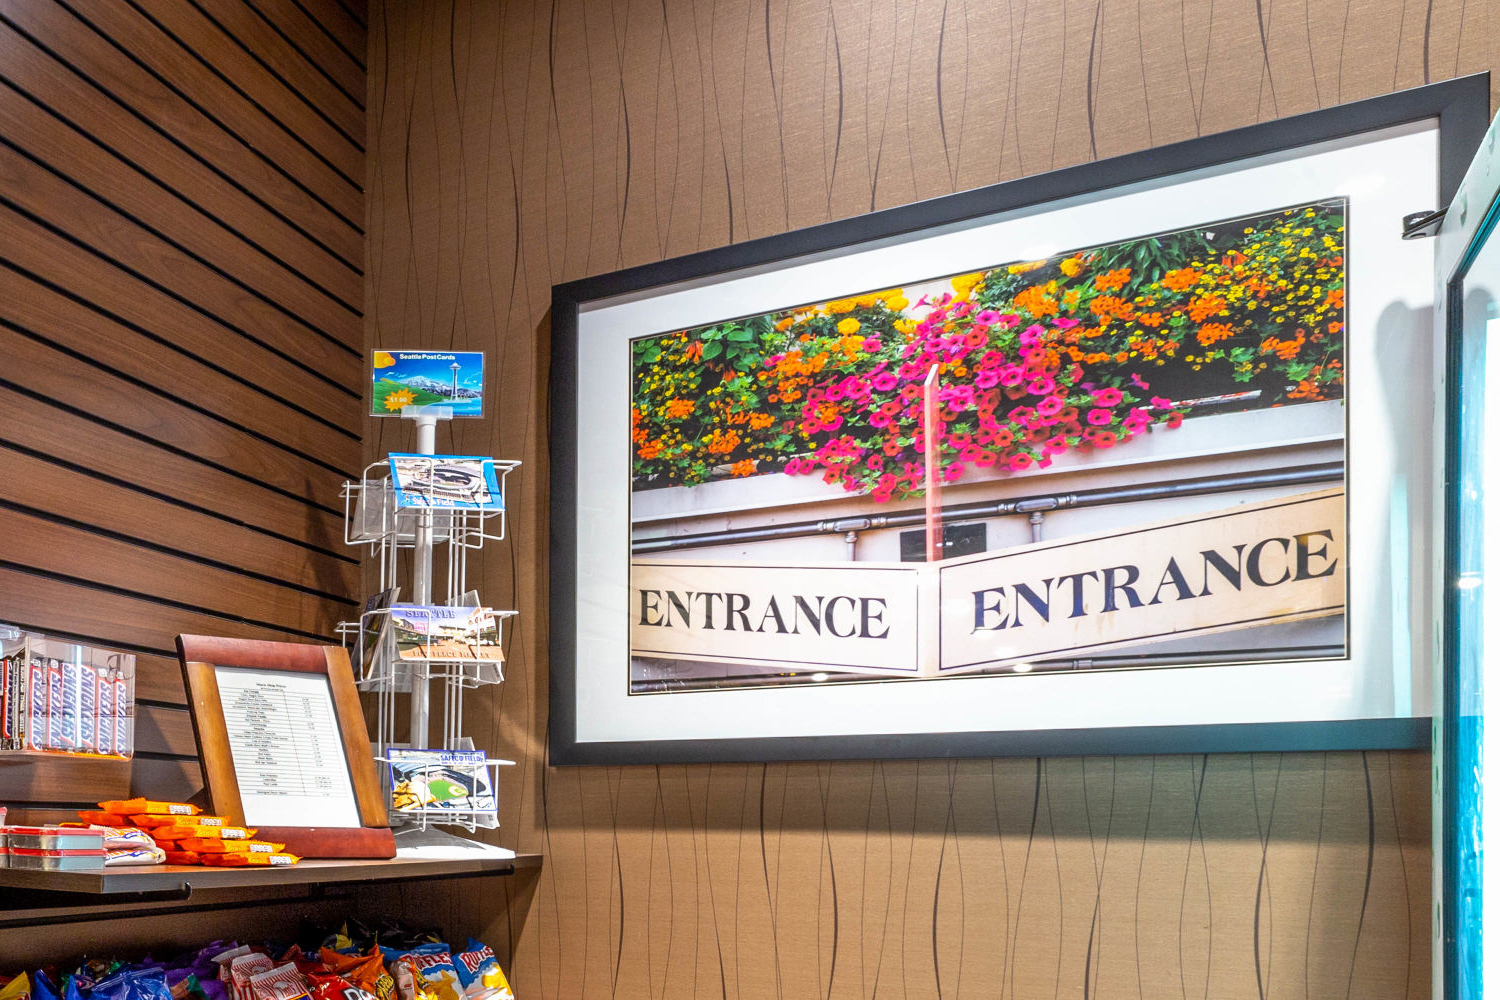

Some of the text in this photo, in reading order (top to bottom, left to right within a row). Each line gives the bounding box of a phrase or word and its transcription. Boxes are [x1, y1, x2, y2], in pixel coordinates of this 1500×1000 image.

[400, 353, 421, 361] Seattle
[437, 354, 456, 362] Cards
[970, 528, 1338, 635] ENTRANCE
[639, 589, 891, 641] ENTRANCE
[62, 663, 77, 744] SNICKERS
